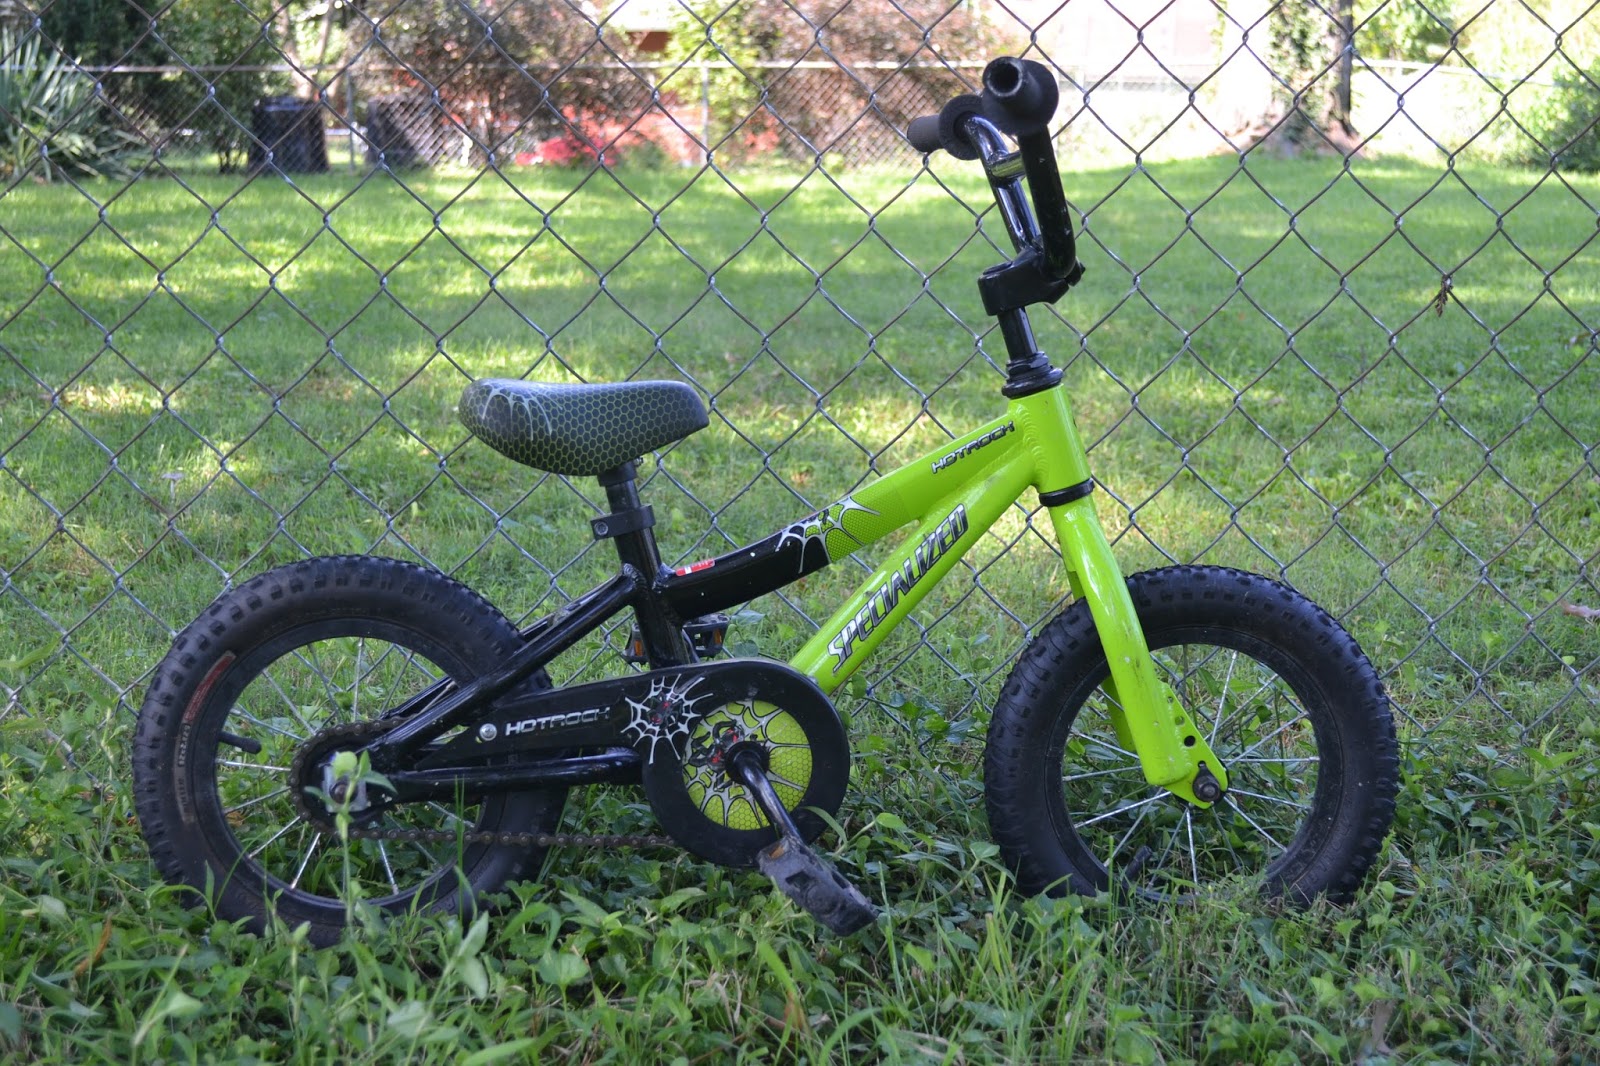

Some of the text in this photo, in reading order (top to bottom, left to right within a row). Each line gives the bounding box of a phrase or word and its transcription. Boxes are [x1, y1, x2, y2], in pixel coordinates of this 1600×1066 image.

[931, 420, 1015, 474] HOTROCK
[827, 503, 968, 673] SPECIALIZED
[505, 707, 611, 736] HOTROCK
